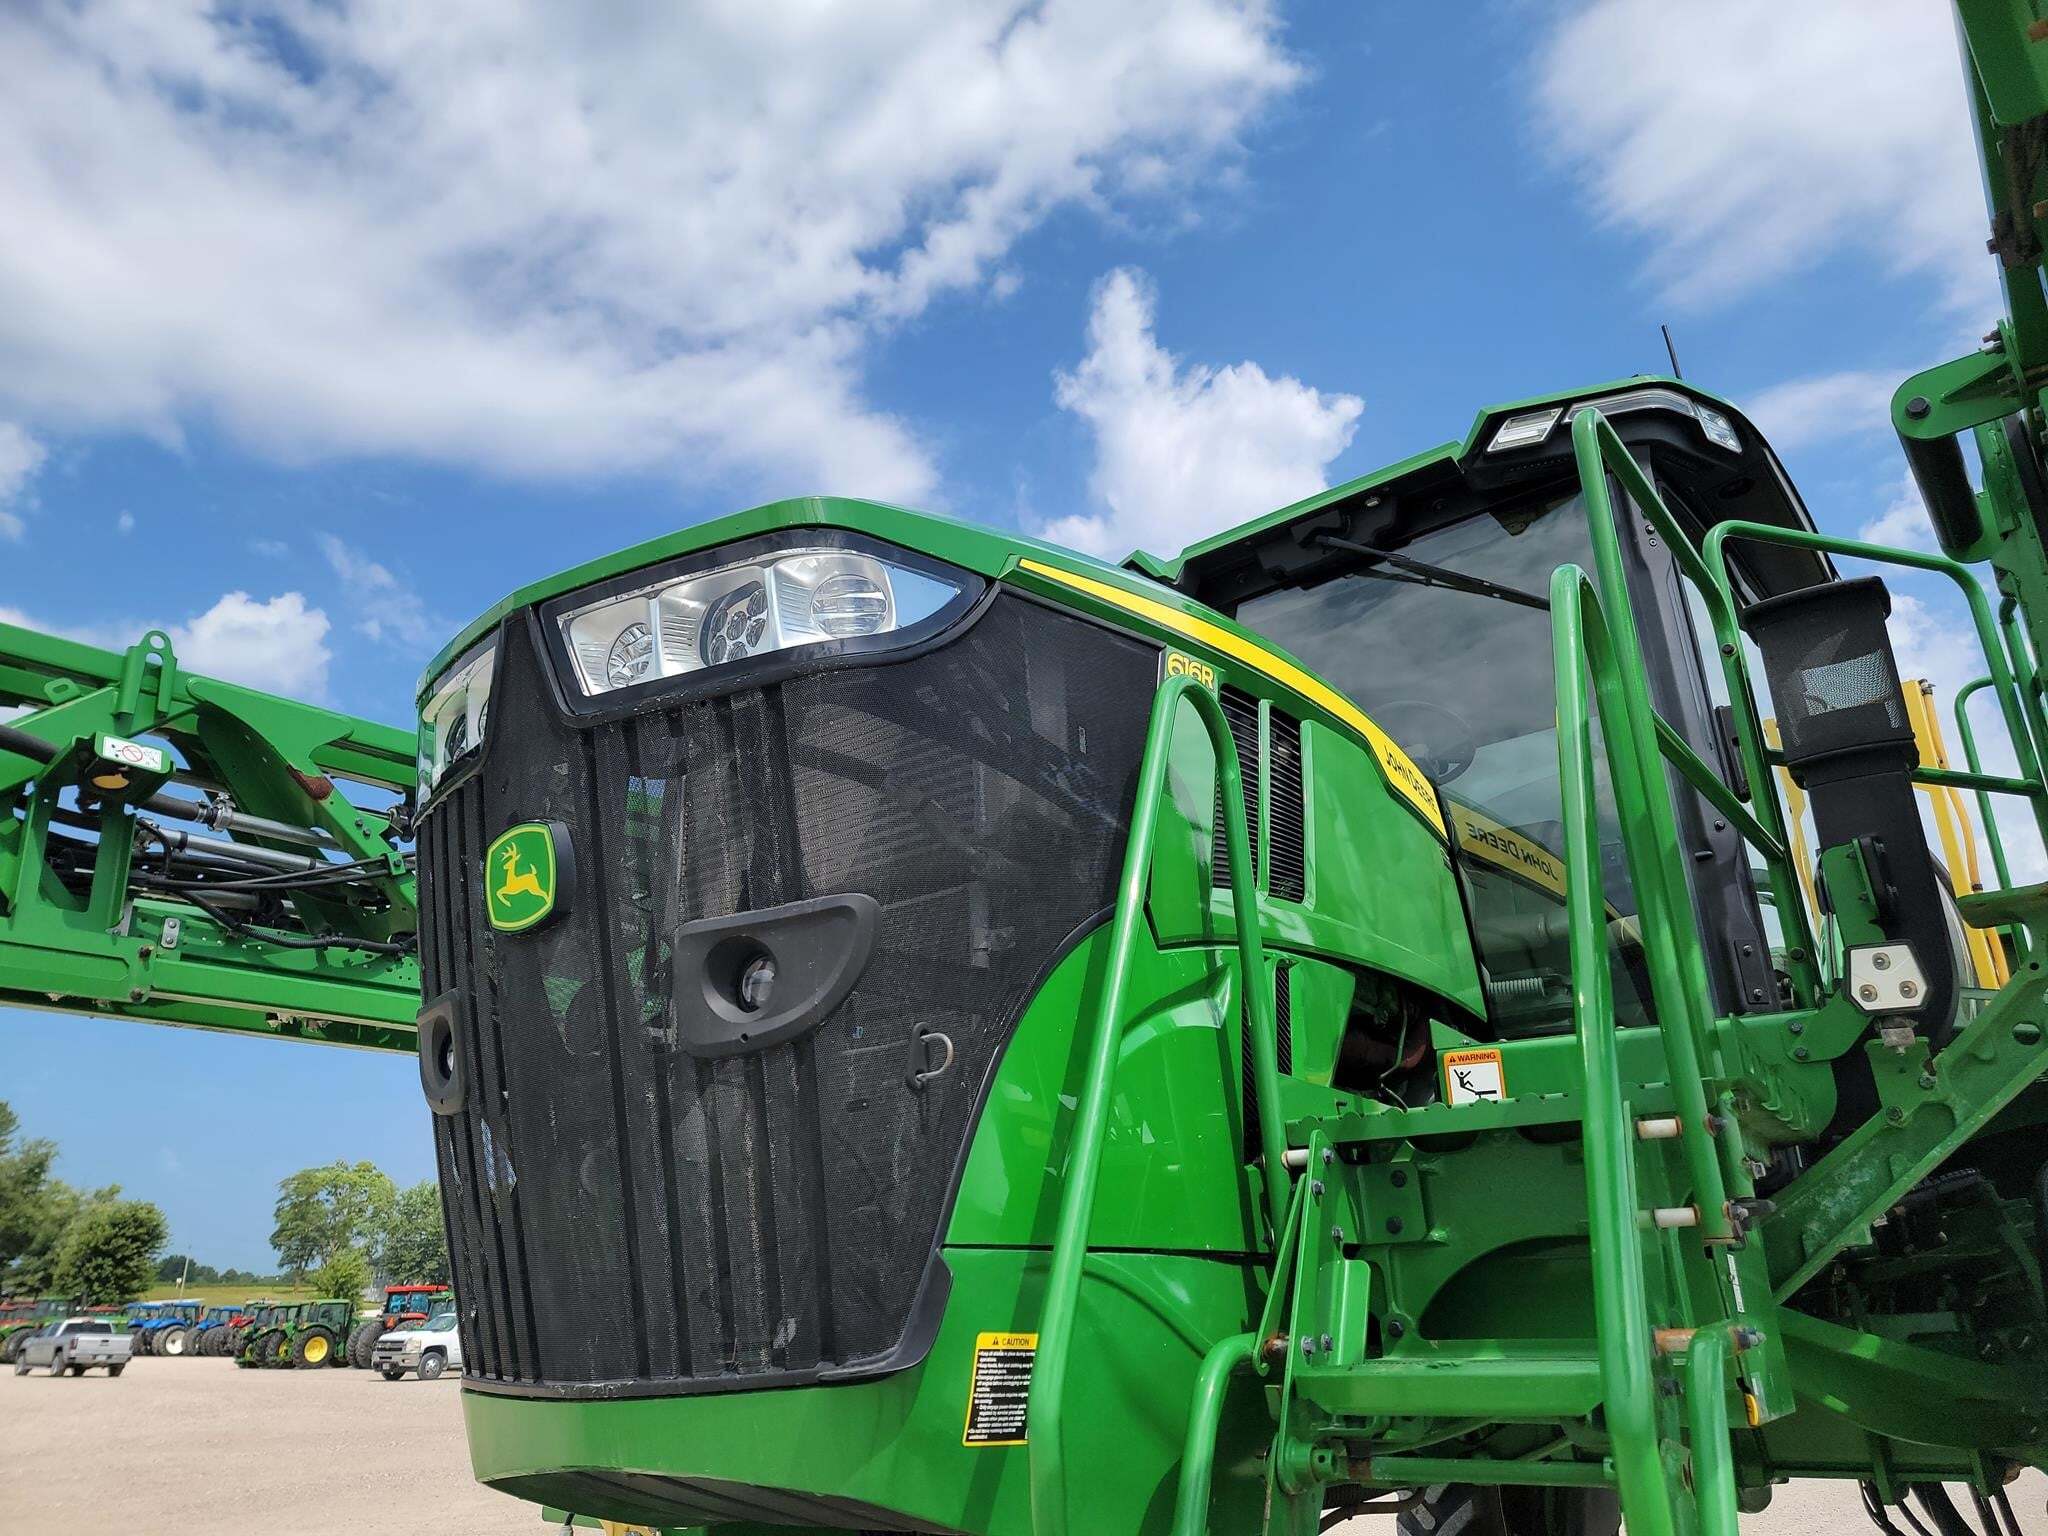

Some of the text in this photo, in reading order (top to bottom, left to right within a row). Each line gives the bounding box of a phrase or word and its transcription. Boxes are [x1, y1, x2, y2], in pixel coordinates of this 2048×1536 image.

[1167, 652, 1215, 690] 616R
[1384, 744, 1411, 785] JOHN
[1458, 1052, 1496, 1062] WARNING
[1002, 1338, 1030, 1346] CAUTION
